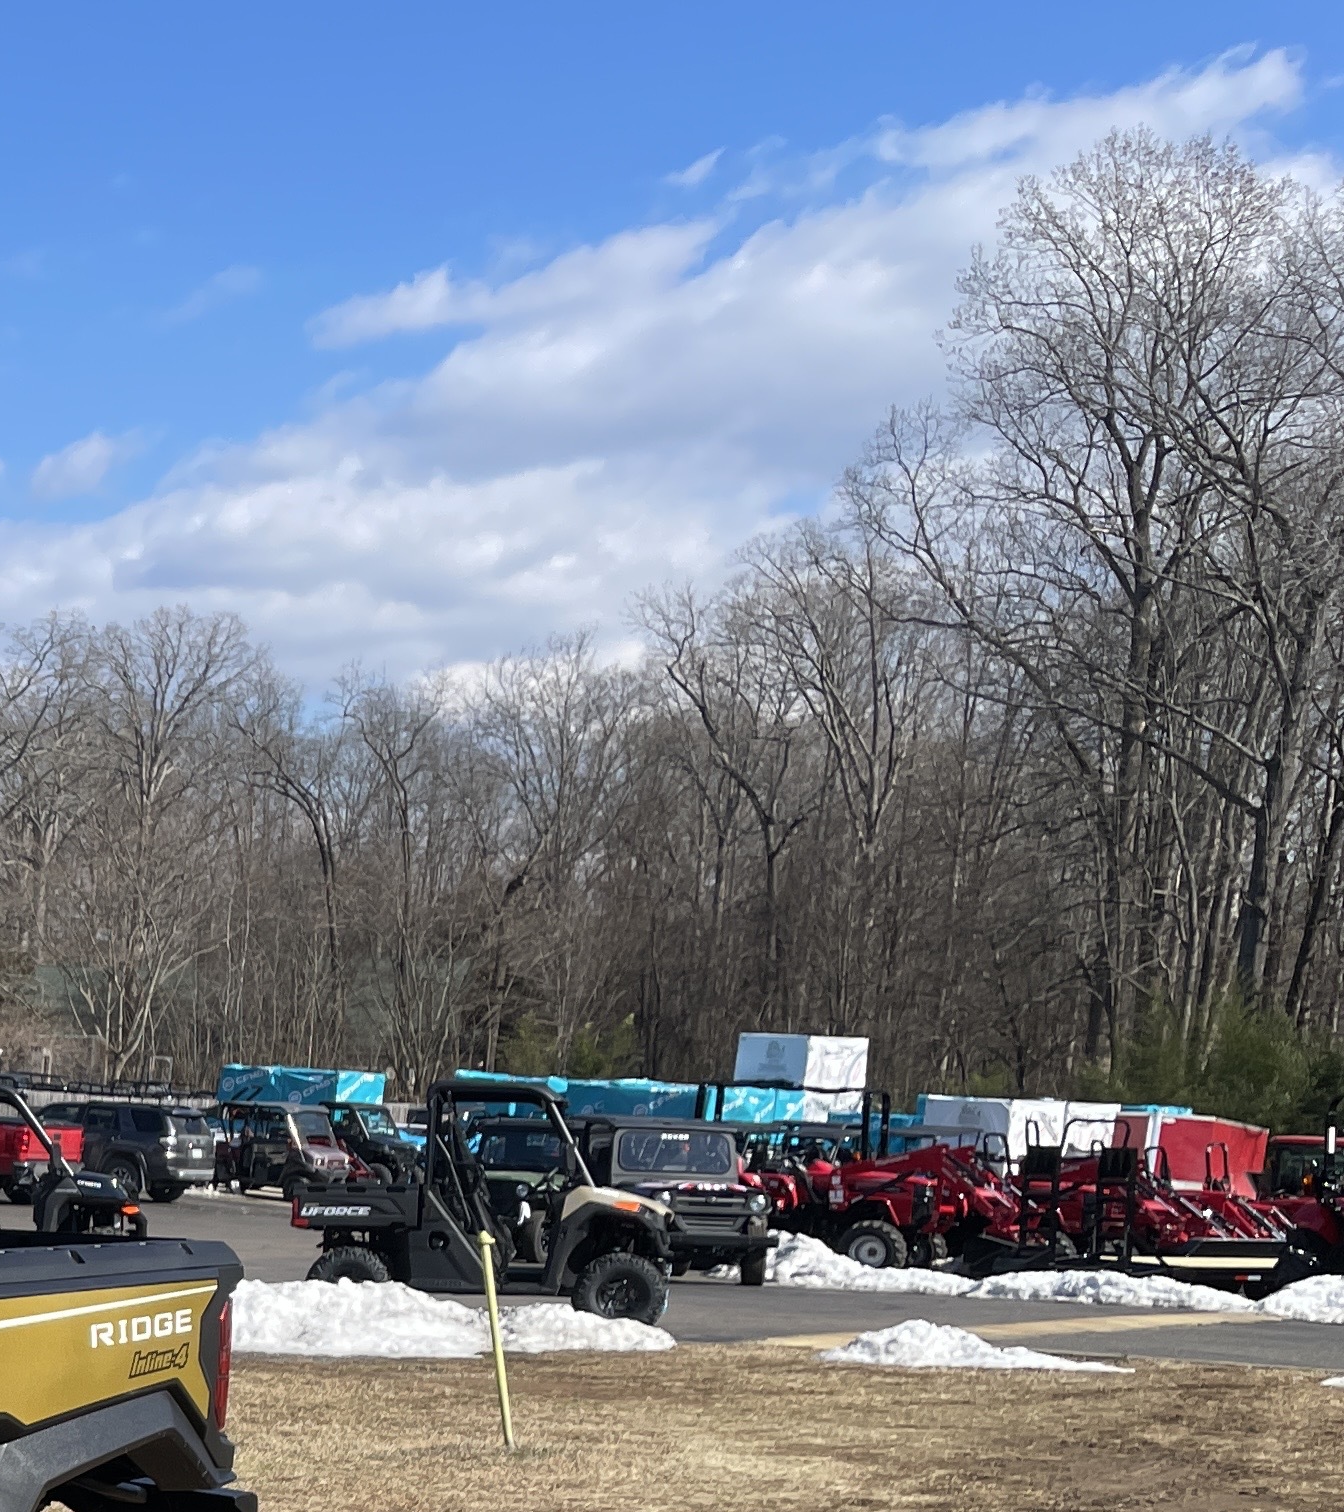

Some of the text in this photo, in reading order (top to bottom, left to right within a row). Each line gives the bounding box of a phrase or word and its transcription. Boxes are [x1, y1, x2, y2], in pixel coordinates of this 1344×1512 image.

[300, 1203, 372, 1216] UFORCE
[90, 1308, 194, 1349] RIDGE
[128, 1342, 190, 1379] Inline-4
